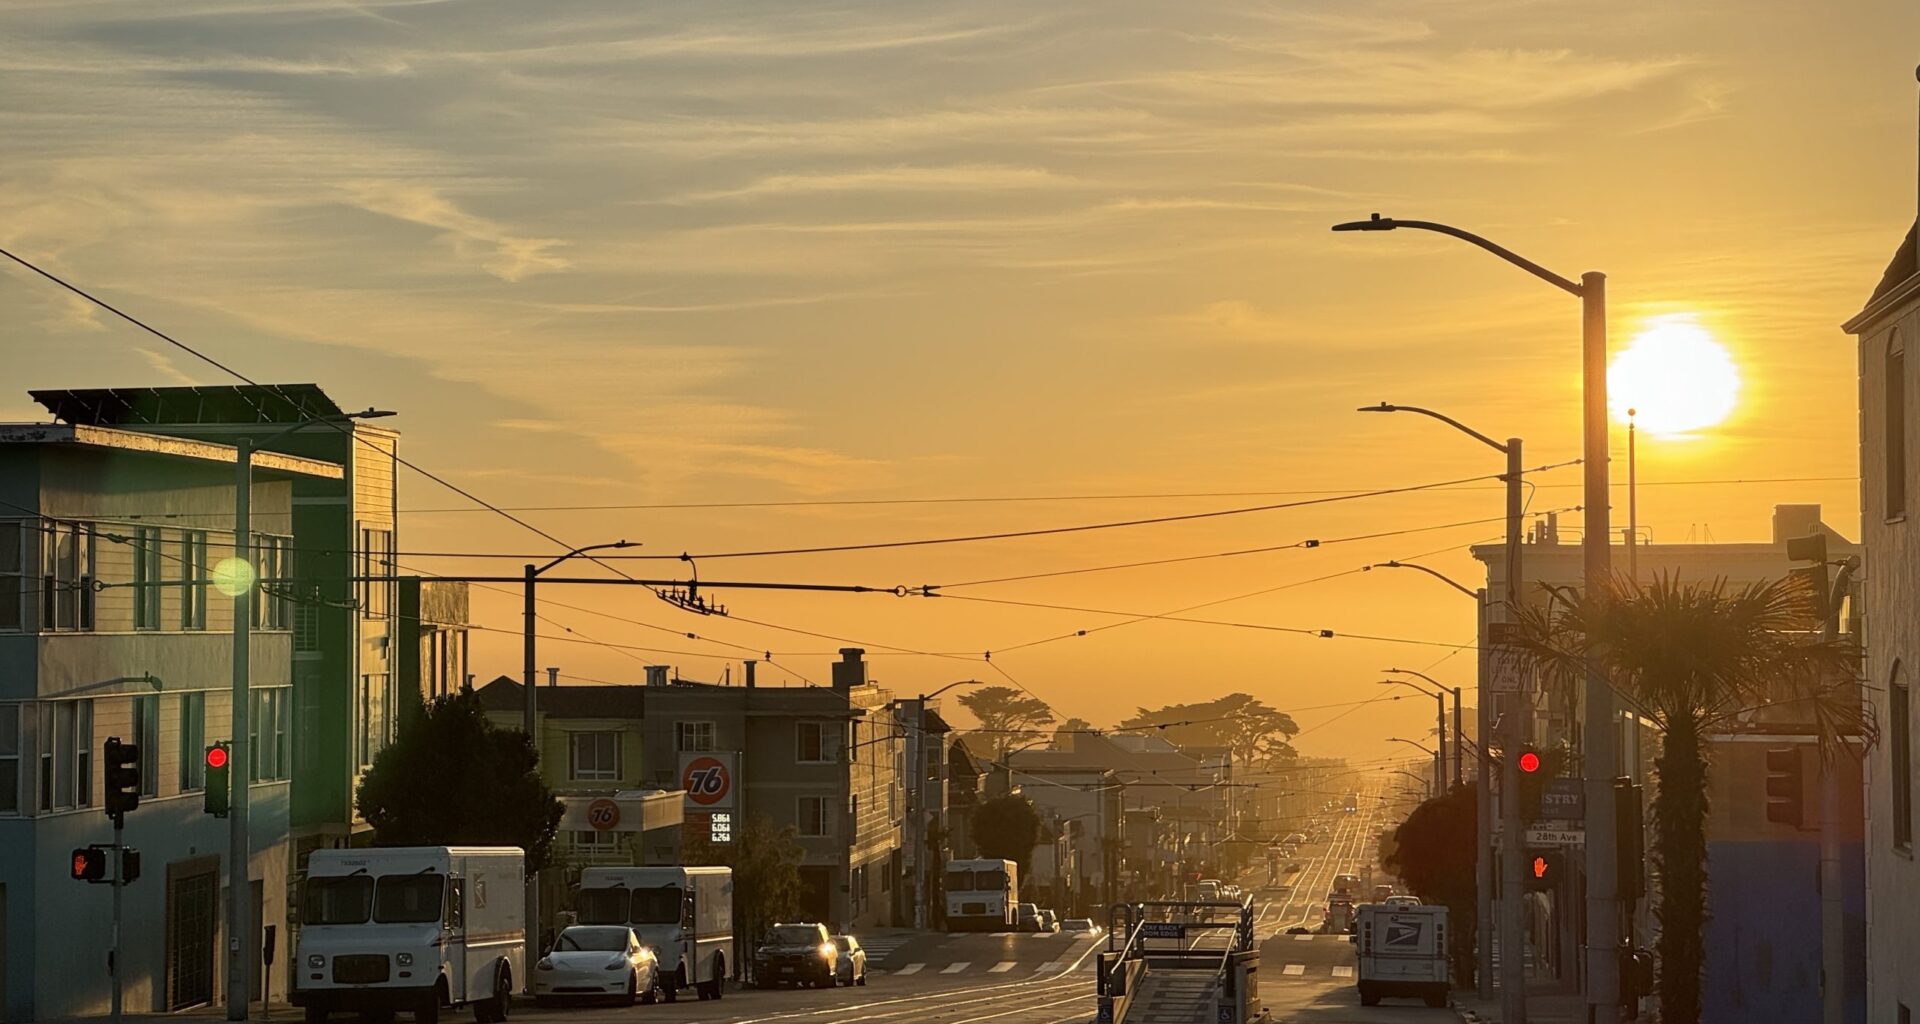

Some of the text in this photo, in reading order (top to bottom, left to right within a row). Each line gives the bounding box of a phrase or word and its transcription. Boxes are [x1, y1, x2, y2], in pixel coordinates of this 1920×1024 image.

[688, 766, 723, 795] 76
[592, 807, 613, 823] 76
[1536, 833, 1577, 842] 28th Ave
